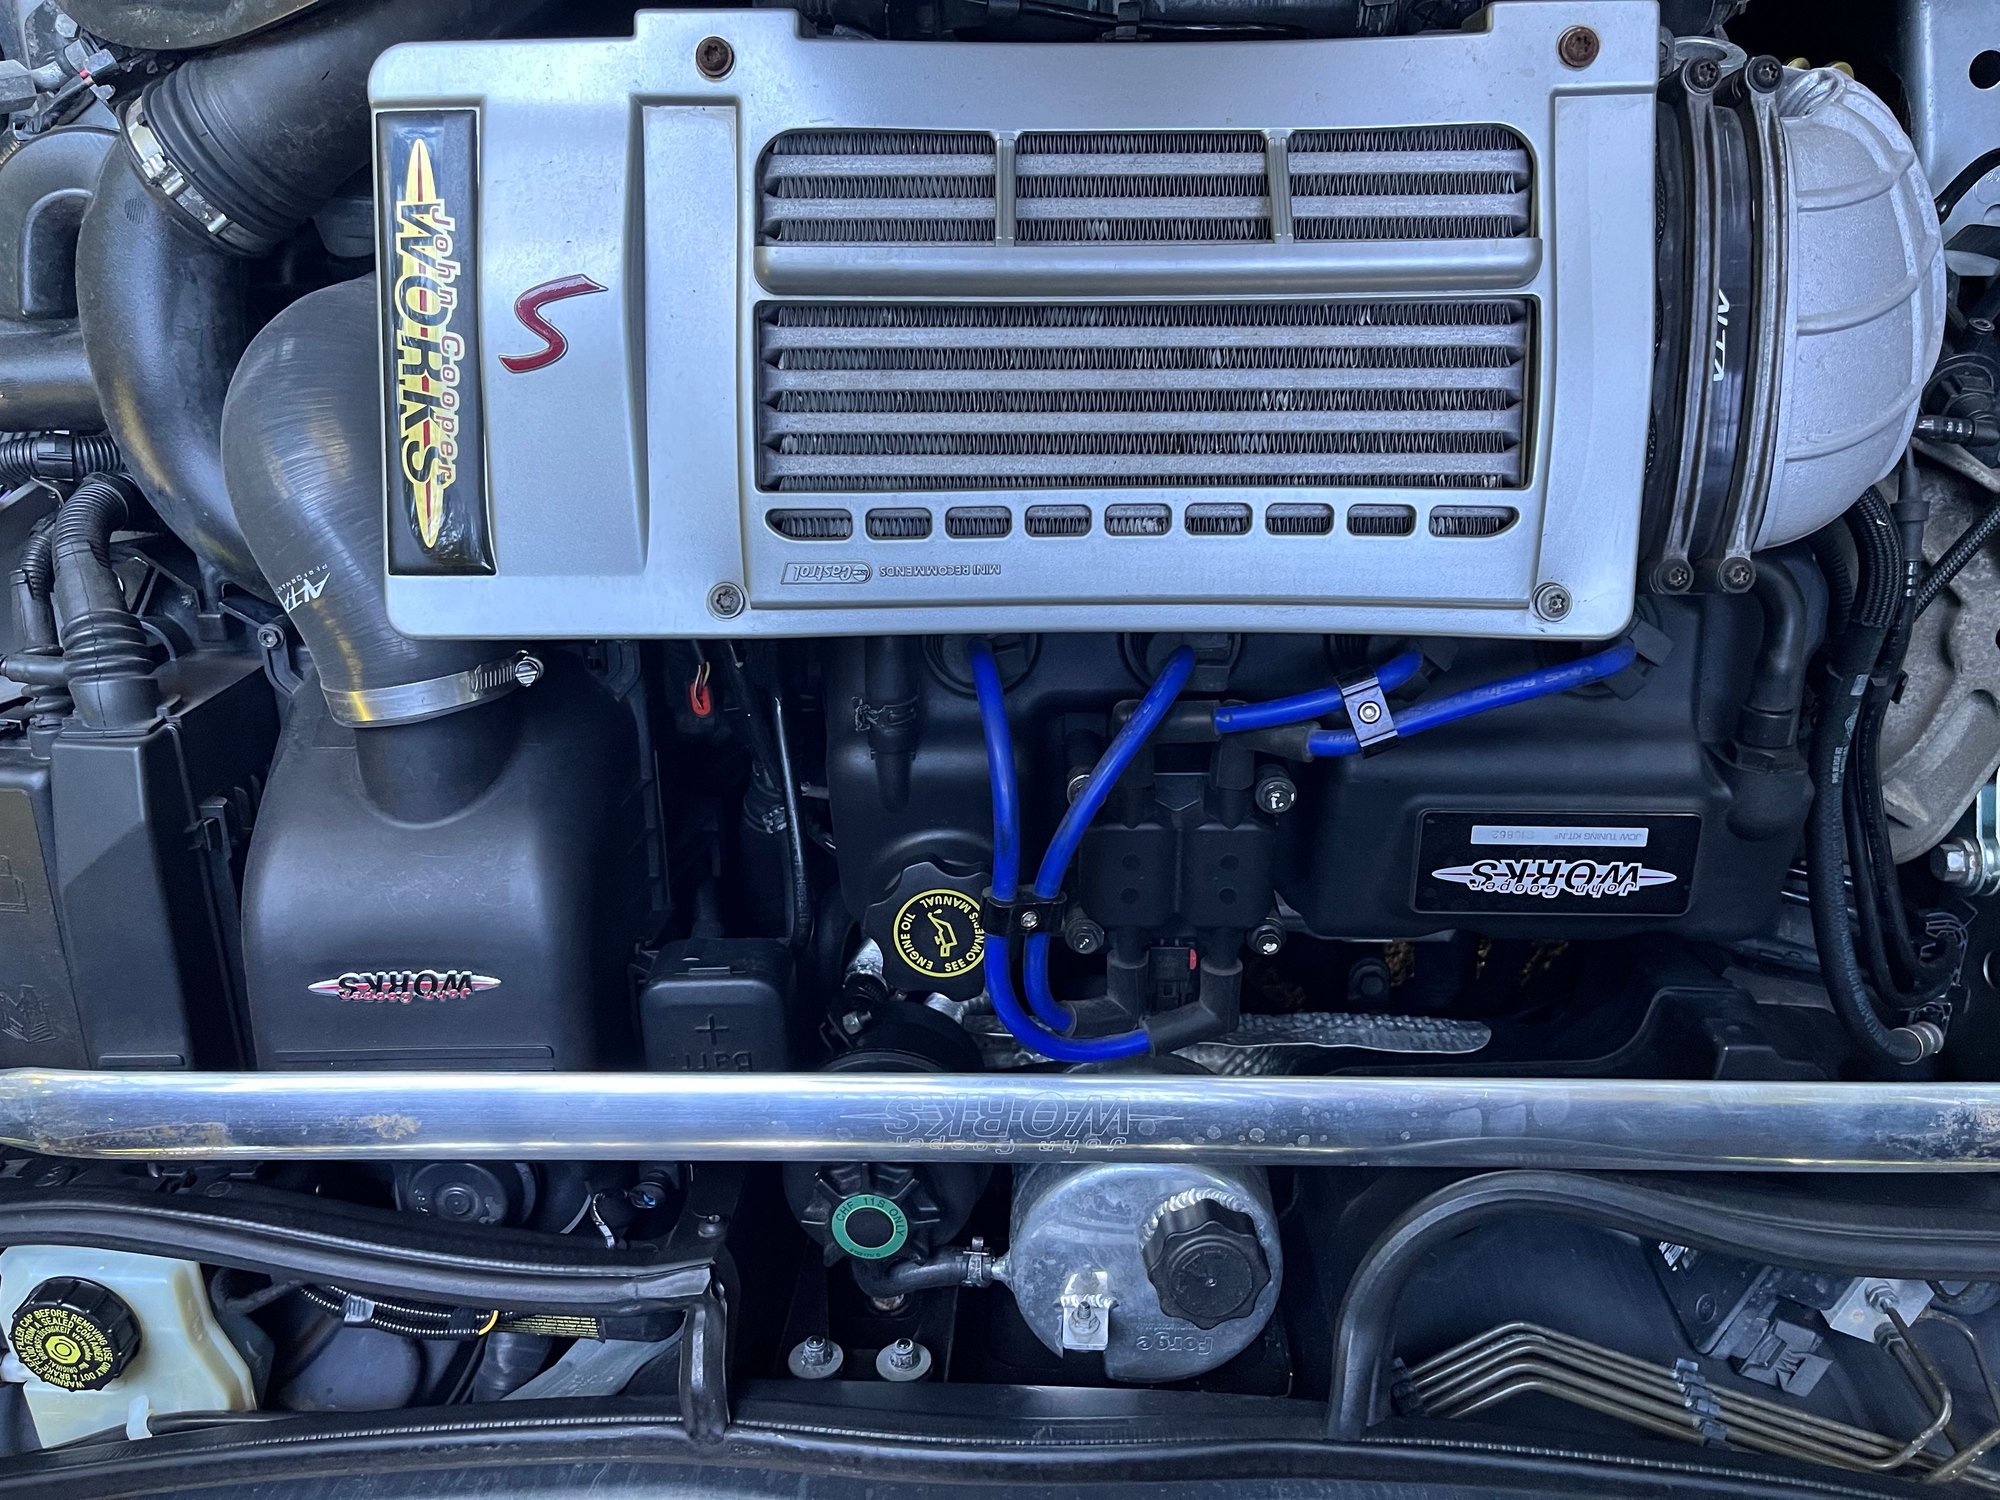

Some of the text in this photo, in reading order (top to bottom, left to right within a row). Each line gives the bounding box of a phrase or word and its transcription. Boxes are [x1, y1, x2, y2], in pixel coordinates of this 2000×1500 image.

[395, 199, 450, 488] WORKS
[430, 204, 466, 486] John Cooper
[793, 564, 853, 582] Castrol
[879, 563, 1001, 578] MINI RECOMMENDS
[1583, 832, 1618, 841] TUNING
[1467, 859, 1642, 891] WORKS
[1467, 878, 1635, 899] John Cooper
[919, 895, 972, 914] MANUAL
[900, 912, 934, 970] ENGINE OIL
[944, 958, 966, 972] SEE
[337, 970, 473, 997] WORKS
[339, 987, 472, 1004] John Cooper
[884, 1091, 1131, 1139] WORKS
[1038, 1137, 1127, 1155] John
[835, 1197, 905, 1237] CHF 11S ONLY
[19, 1313, 34, 1328] CAP
[33, 1308, 69, 1319] BEFORE
[40, 1317, 75, 1329] SEALED
[15, 1326, 26, 1351] FILLER
[24, 1325, 37, 1345] FROM
[71, 1313, 108, 1346] REMOVING
[75, 1325, 104, 1362] CONTAINER
[1136, 1331, 1214, 1356] Forge
[19, 1351, 43, 1375] CLEAN
[25, 1346, 43, 1365] FLUID
[102, 1347, 114, 1363] USE
[41, 1364, 71, 1381] BRAKE
[80, 1371, 97, 1382] DOT
[96, 1361, 112, 1377] ONLY
[44, 1373, 85, 1389] WARNING
